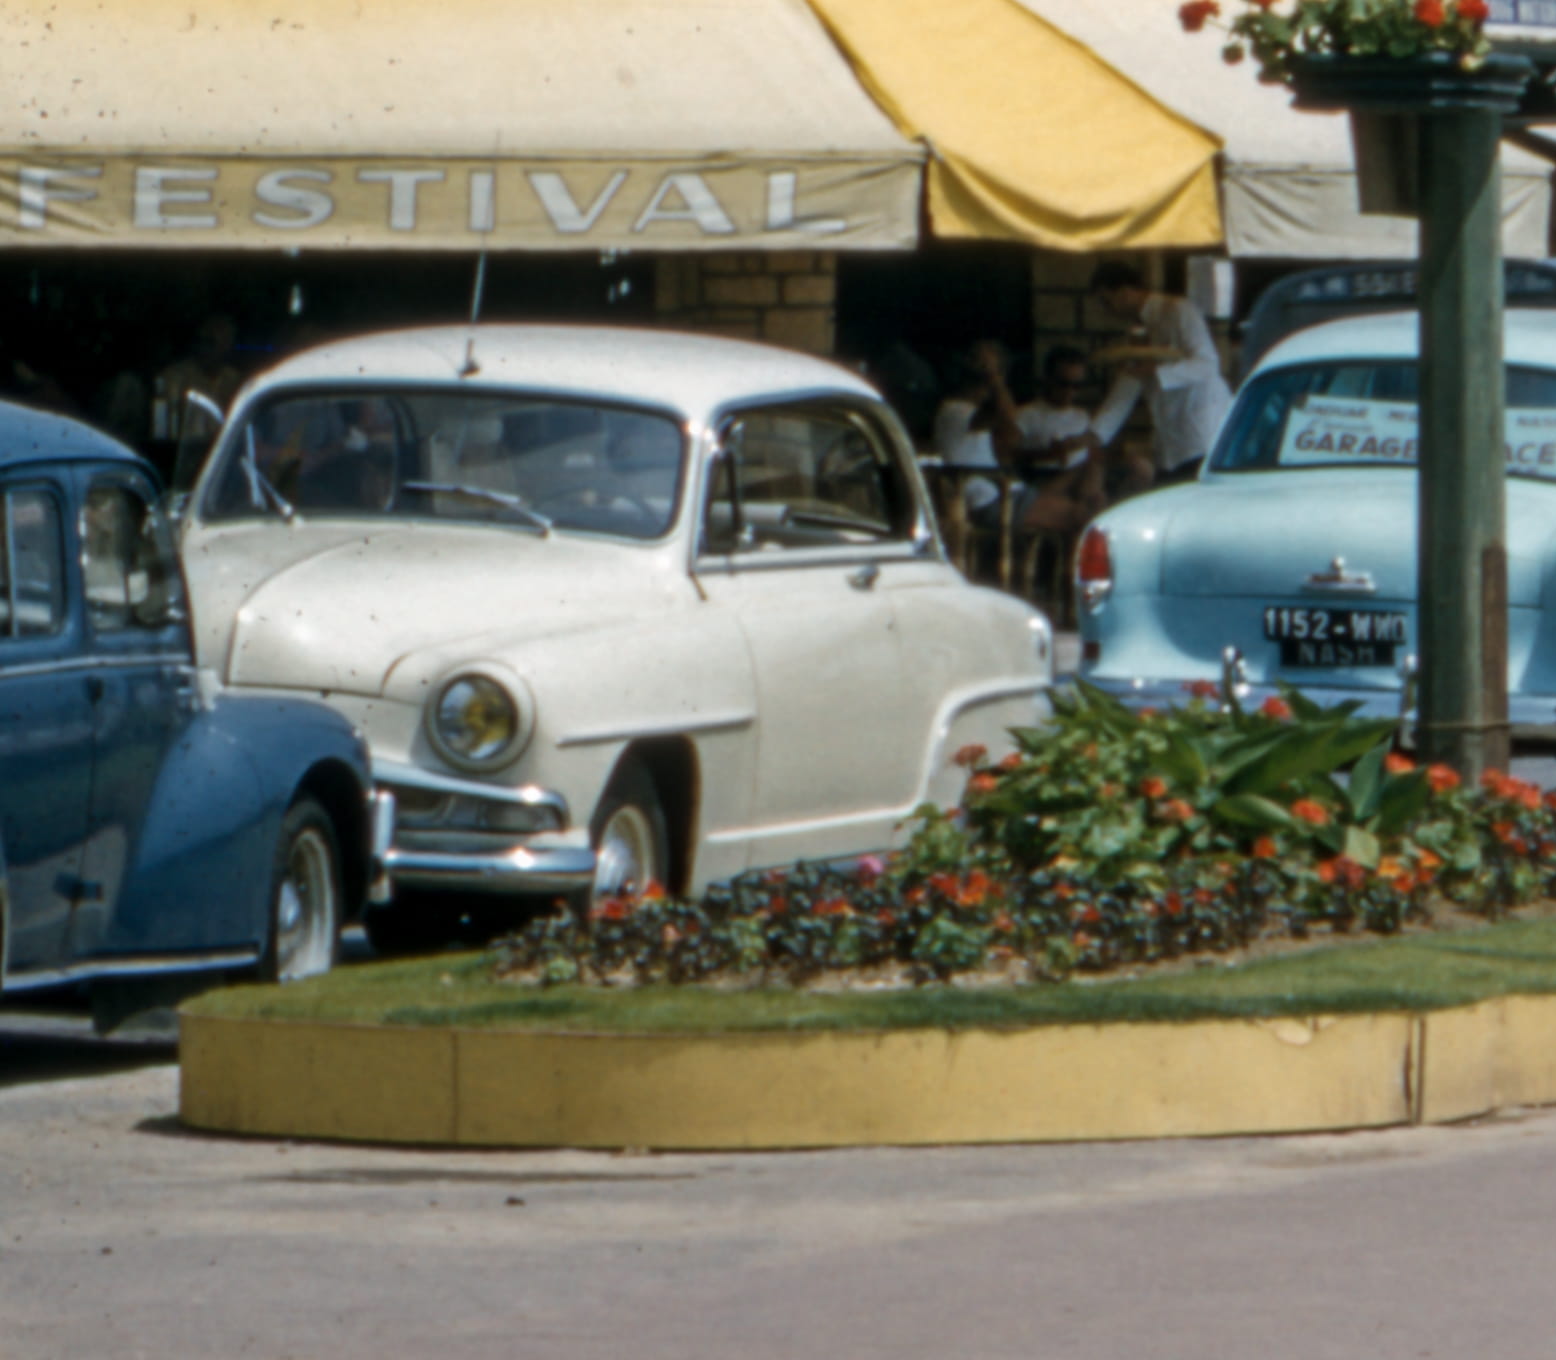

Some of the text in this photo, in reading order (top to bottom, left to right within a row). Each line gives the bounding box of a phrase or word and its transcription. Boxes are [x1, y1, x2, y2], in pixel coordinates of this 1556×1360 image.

[18, 165, 848, 235] FESTIVAL
[1294, 430, 1418, 458] GARAGE
[1301, 643, 1375, 665] NASH
